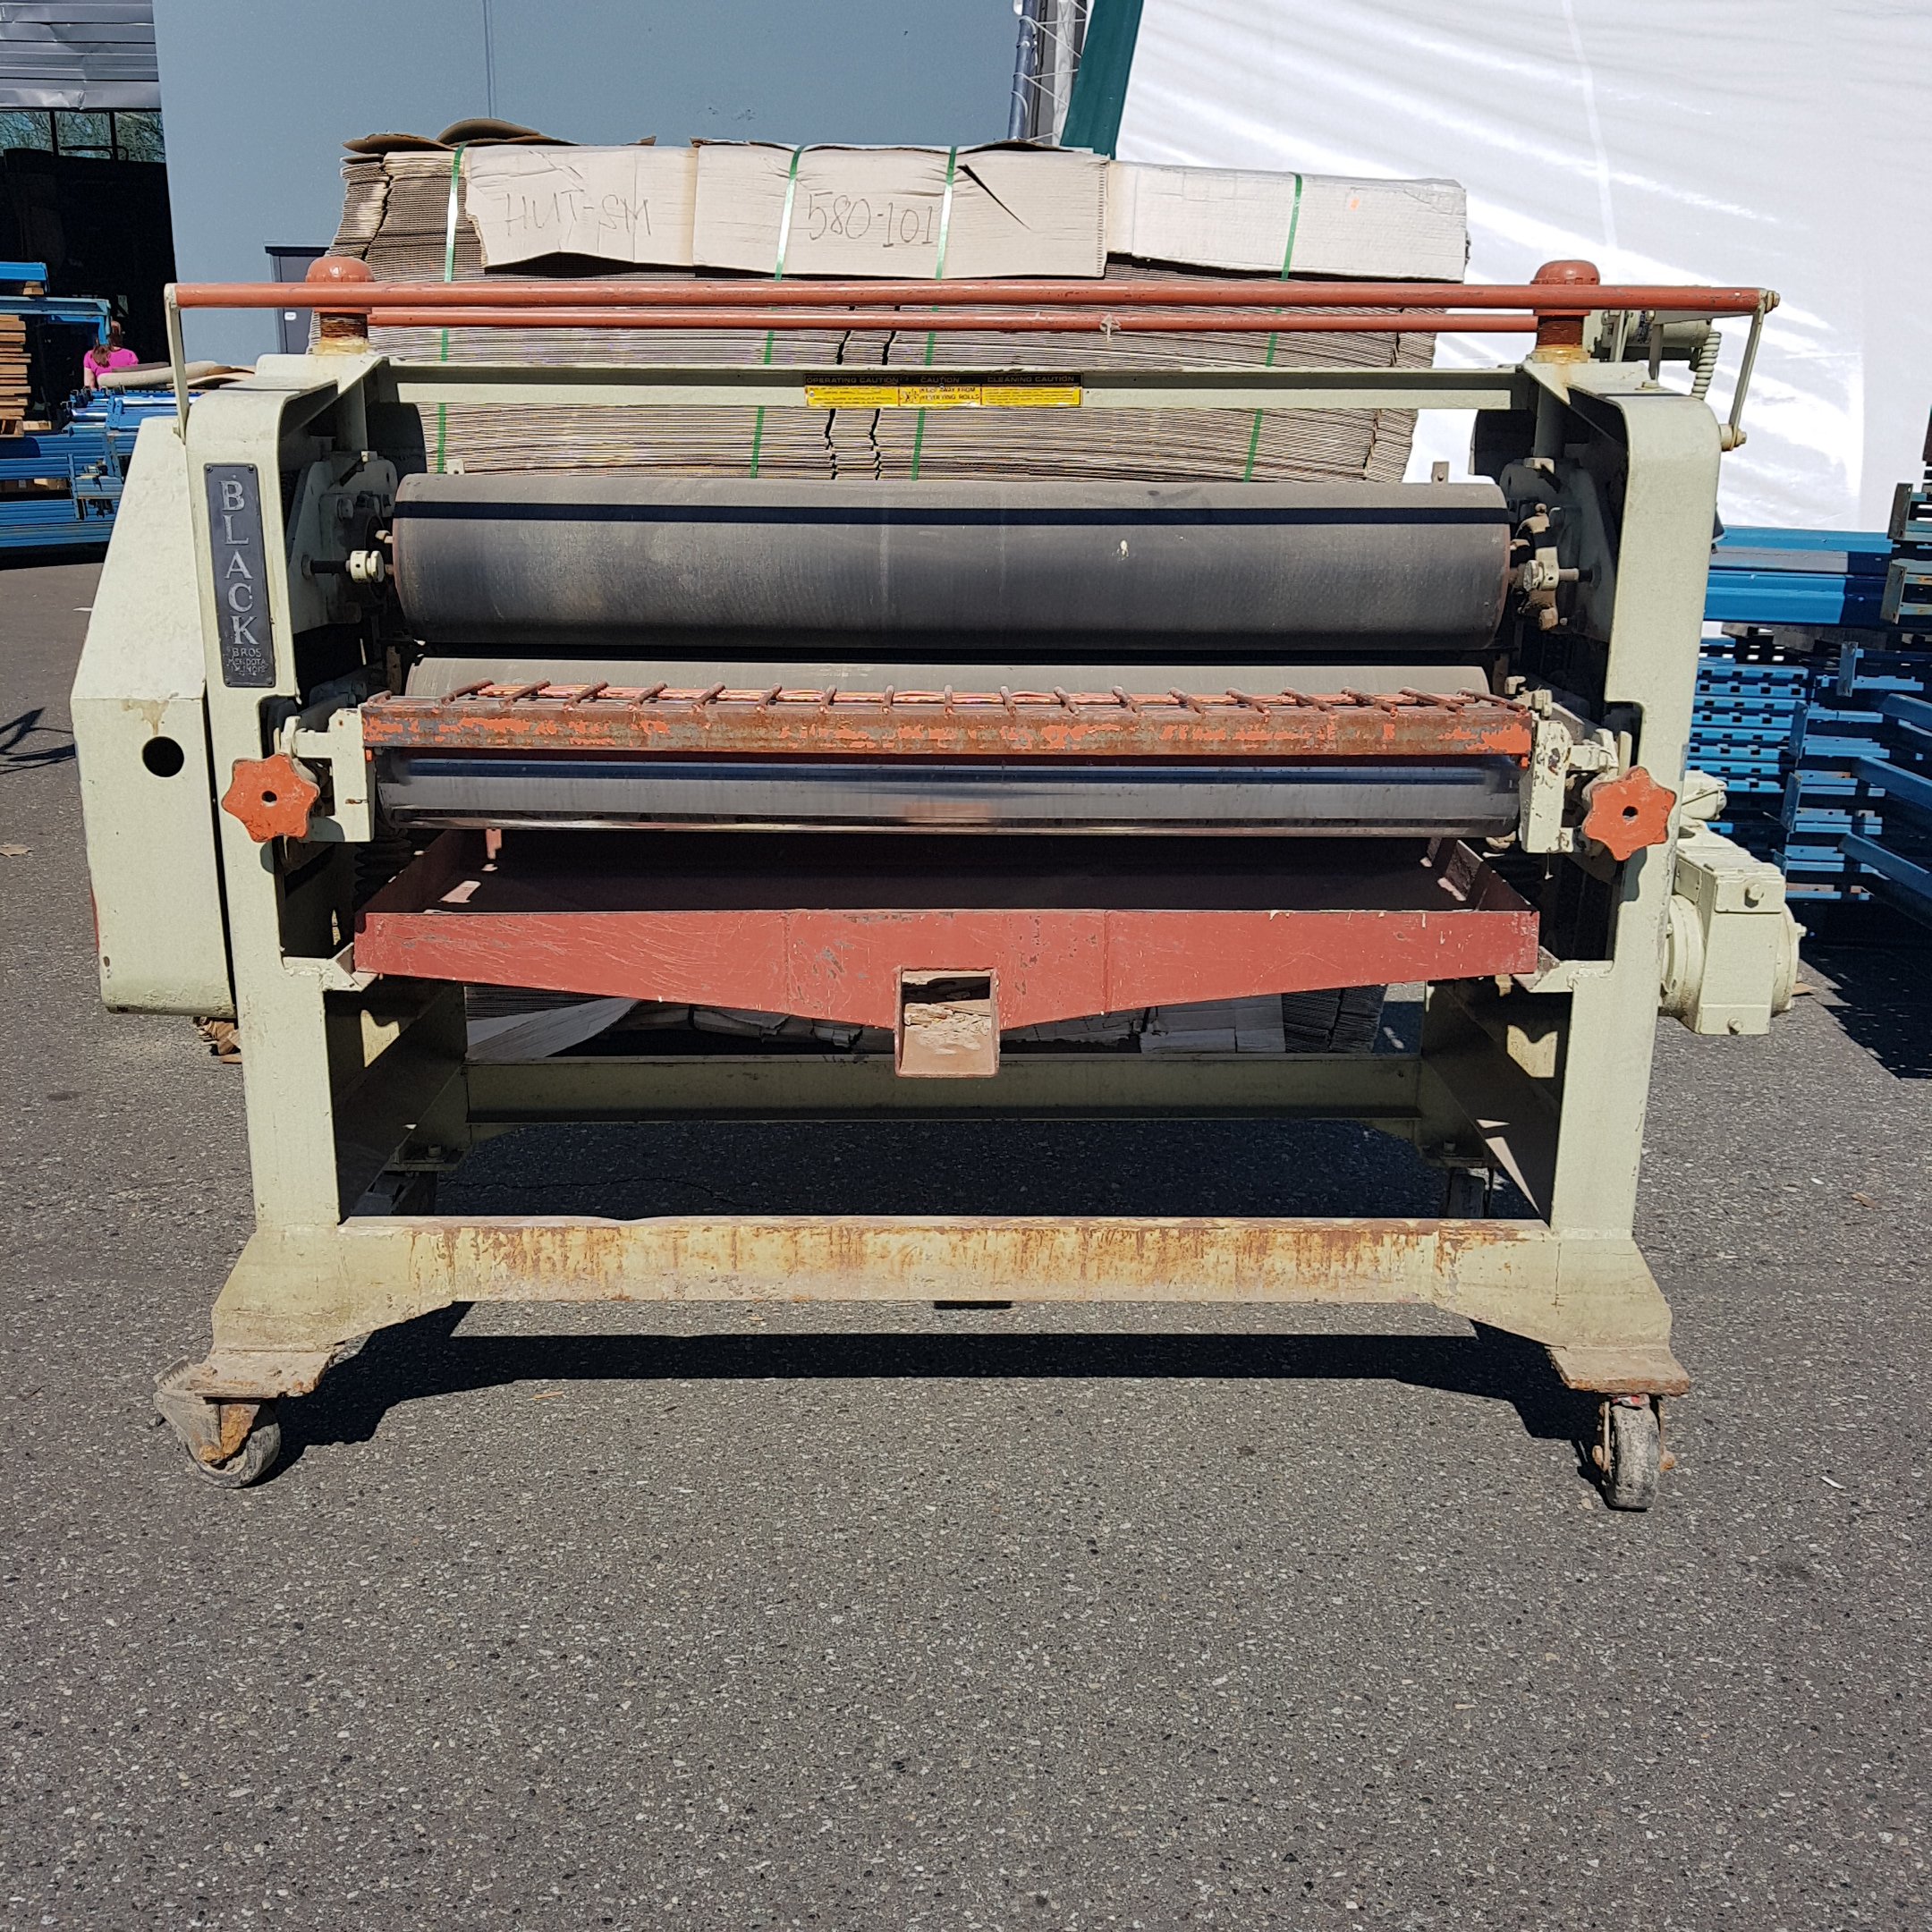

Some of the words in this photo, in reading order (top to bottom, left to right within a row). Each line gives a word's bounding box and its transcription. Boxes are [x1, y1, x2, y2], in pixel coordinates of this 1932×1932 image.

[808, 191, 934, 248] 580-101
[806, 376, 857, 384] OPERATING
[860, 376, 899, 384] CAUTION
[219, 480, 259, 645] BLACK
[232, 648, 262, 657] BROS
